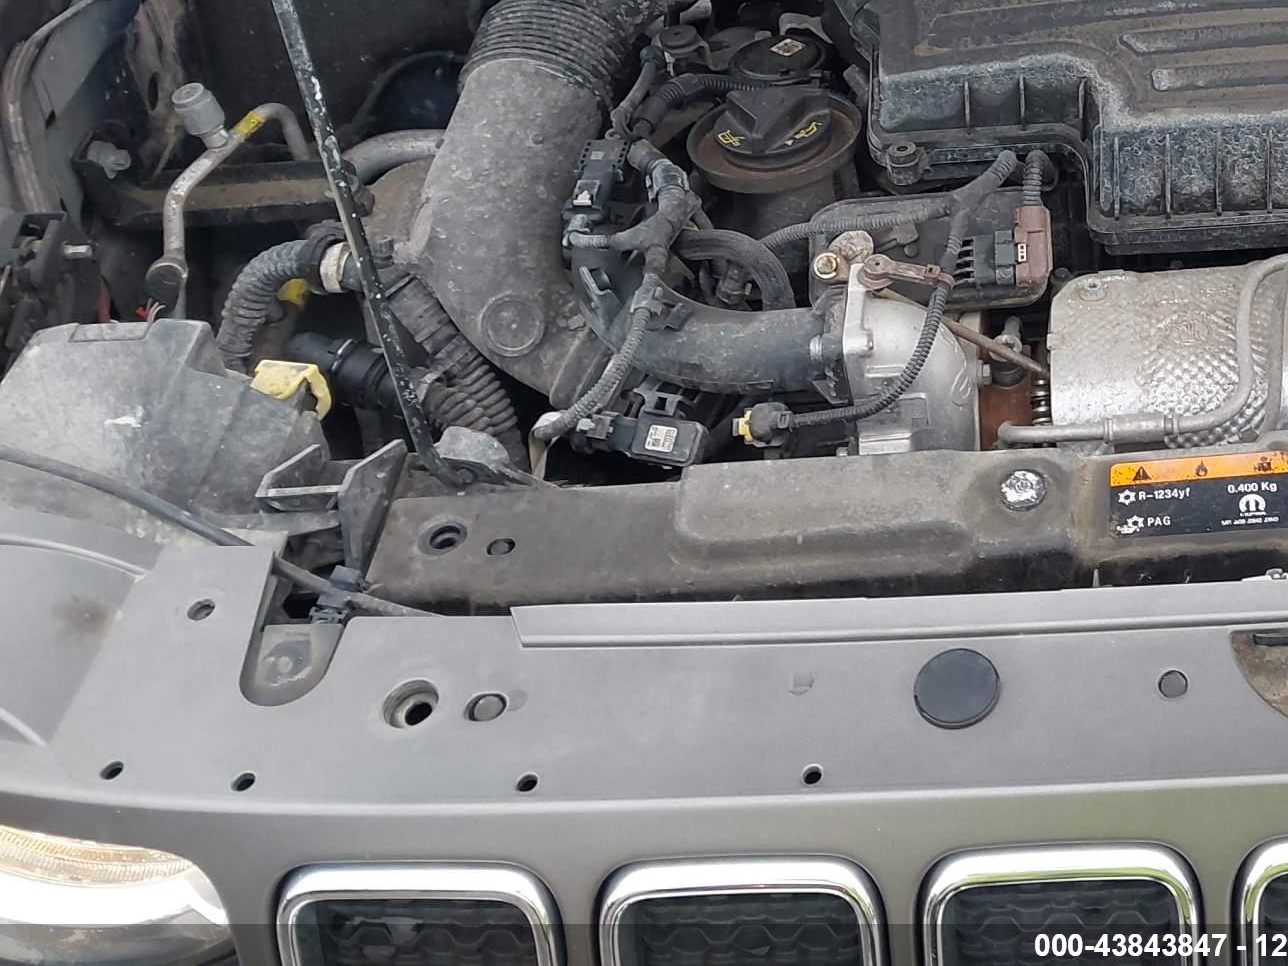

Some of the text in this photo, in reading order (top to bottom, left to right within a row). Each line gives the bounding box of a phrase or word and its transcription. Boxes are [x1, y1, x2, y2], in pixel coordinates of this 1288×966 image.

[1138, 487, 1191, 501] R-1234yf
[1227, 481, 1278, 494] 0.400 Kg
[1147, 516, 1172, 528] PAG
